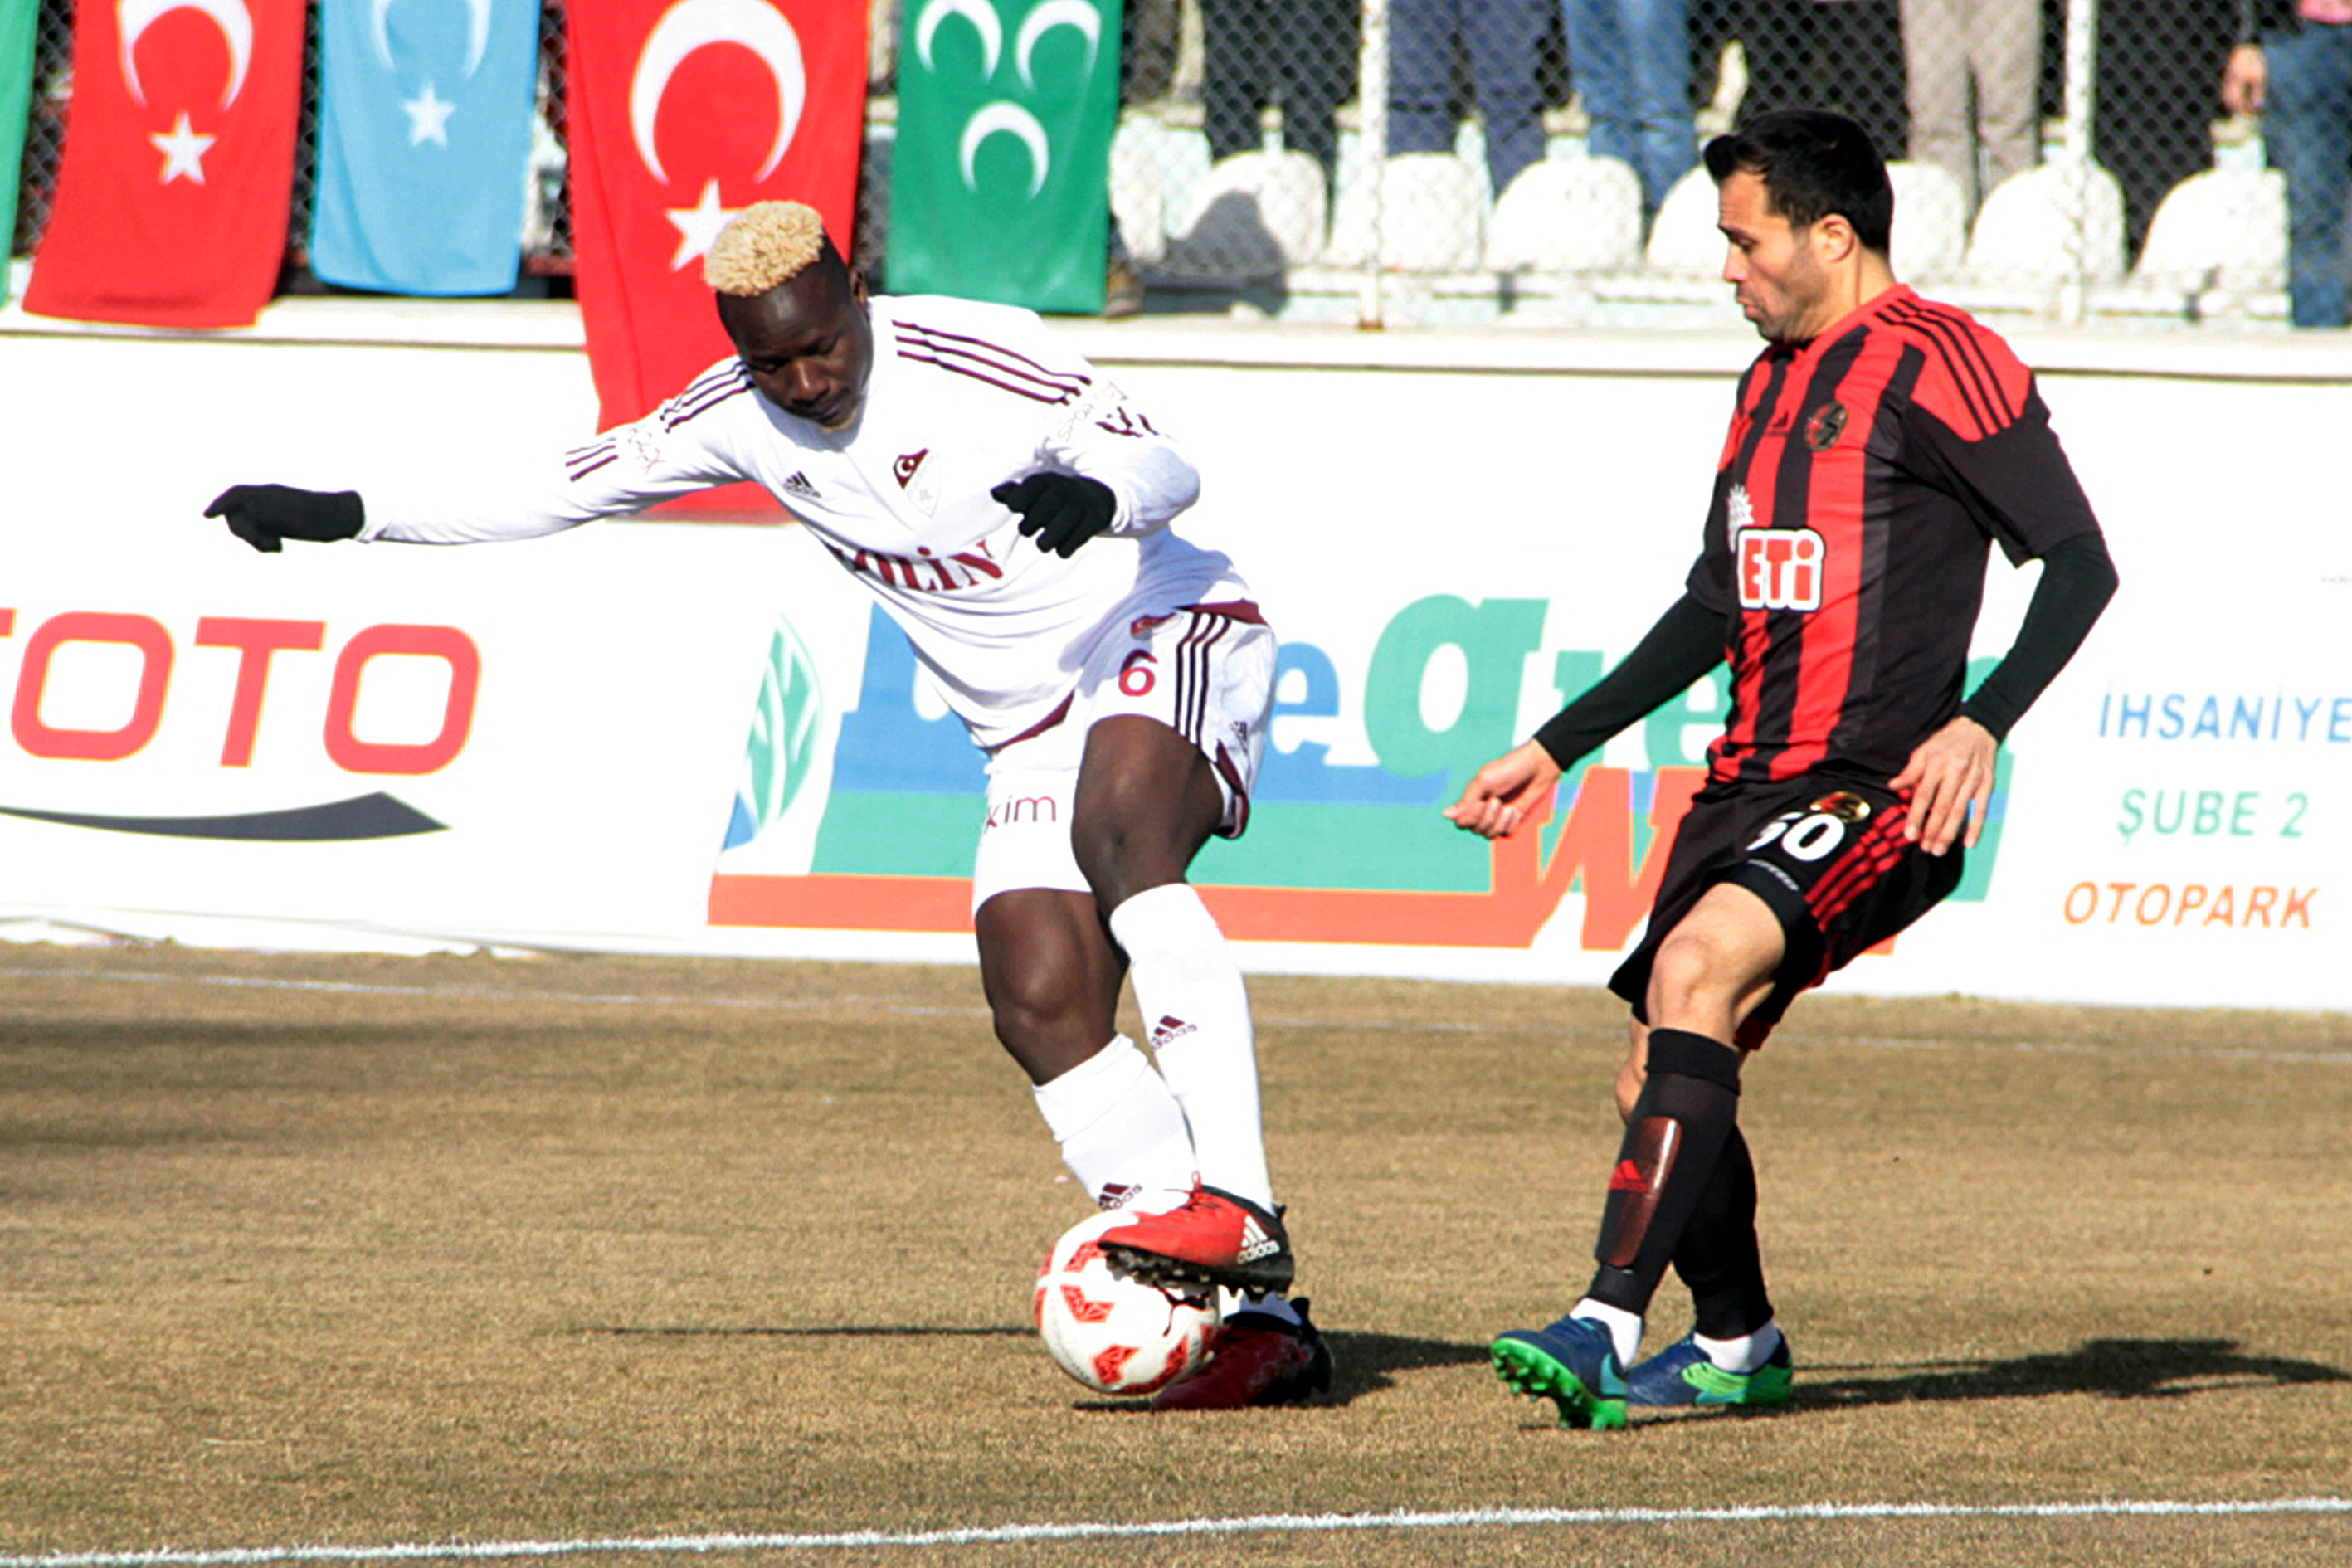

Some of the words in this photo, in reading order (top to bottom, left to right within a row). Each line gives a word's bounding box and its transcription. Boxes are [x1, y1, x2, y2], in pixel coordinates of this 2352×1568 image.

[0, 607, 483, 777] OTO
[1118, 649, 1157, 697] 6
[2116, 788, 2260, 846] ŞUBE
[2279, 791, 2309, 838] 2
[2062, 881, 2320, 929] OTOPARK
